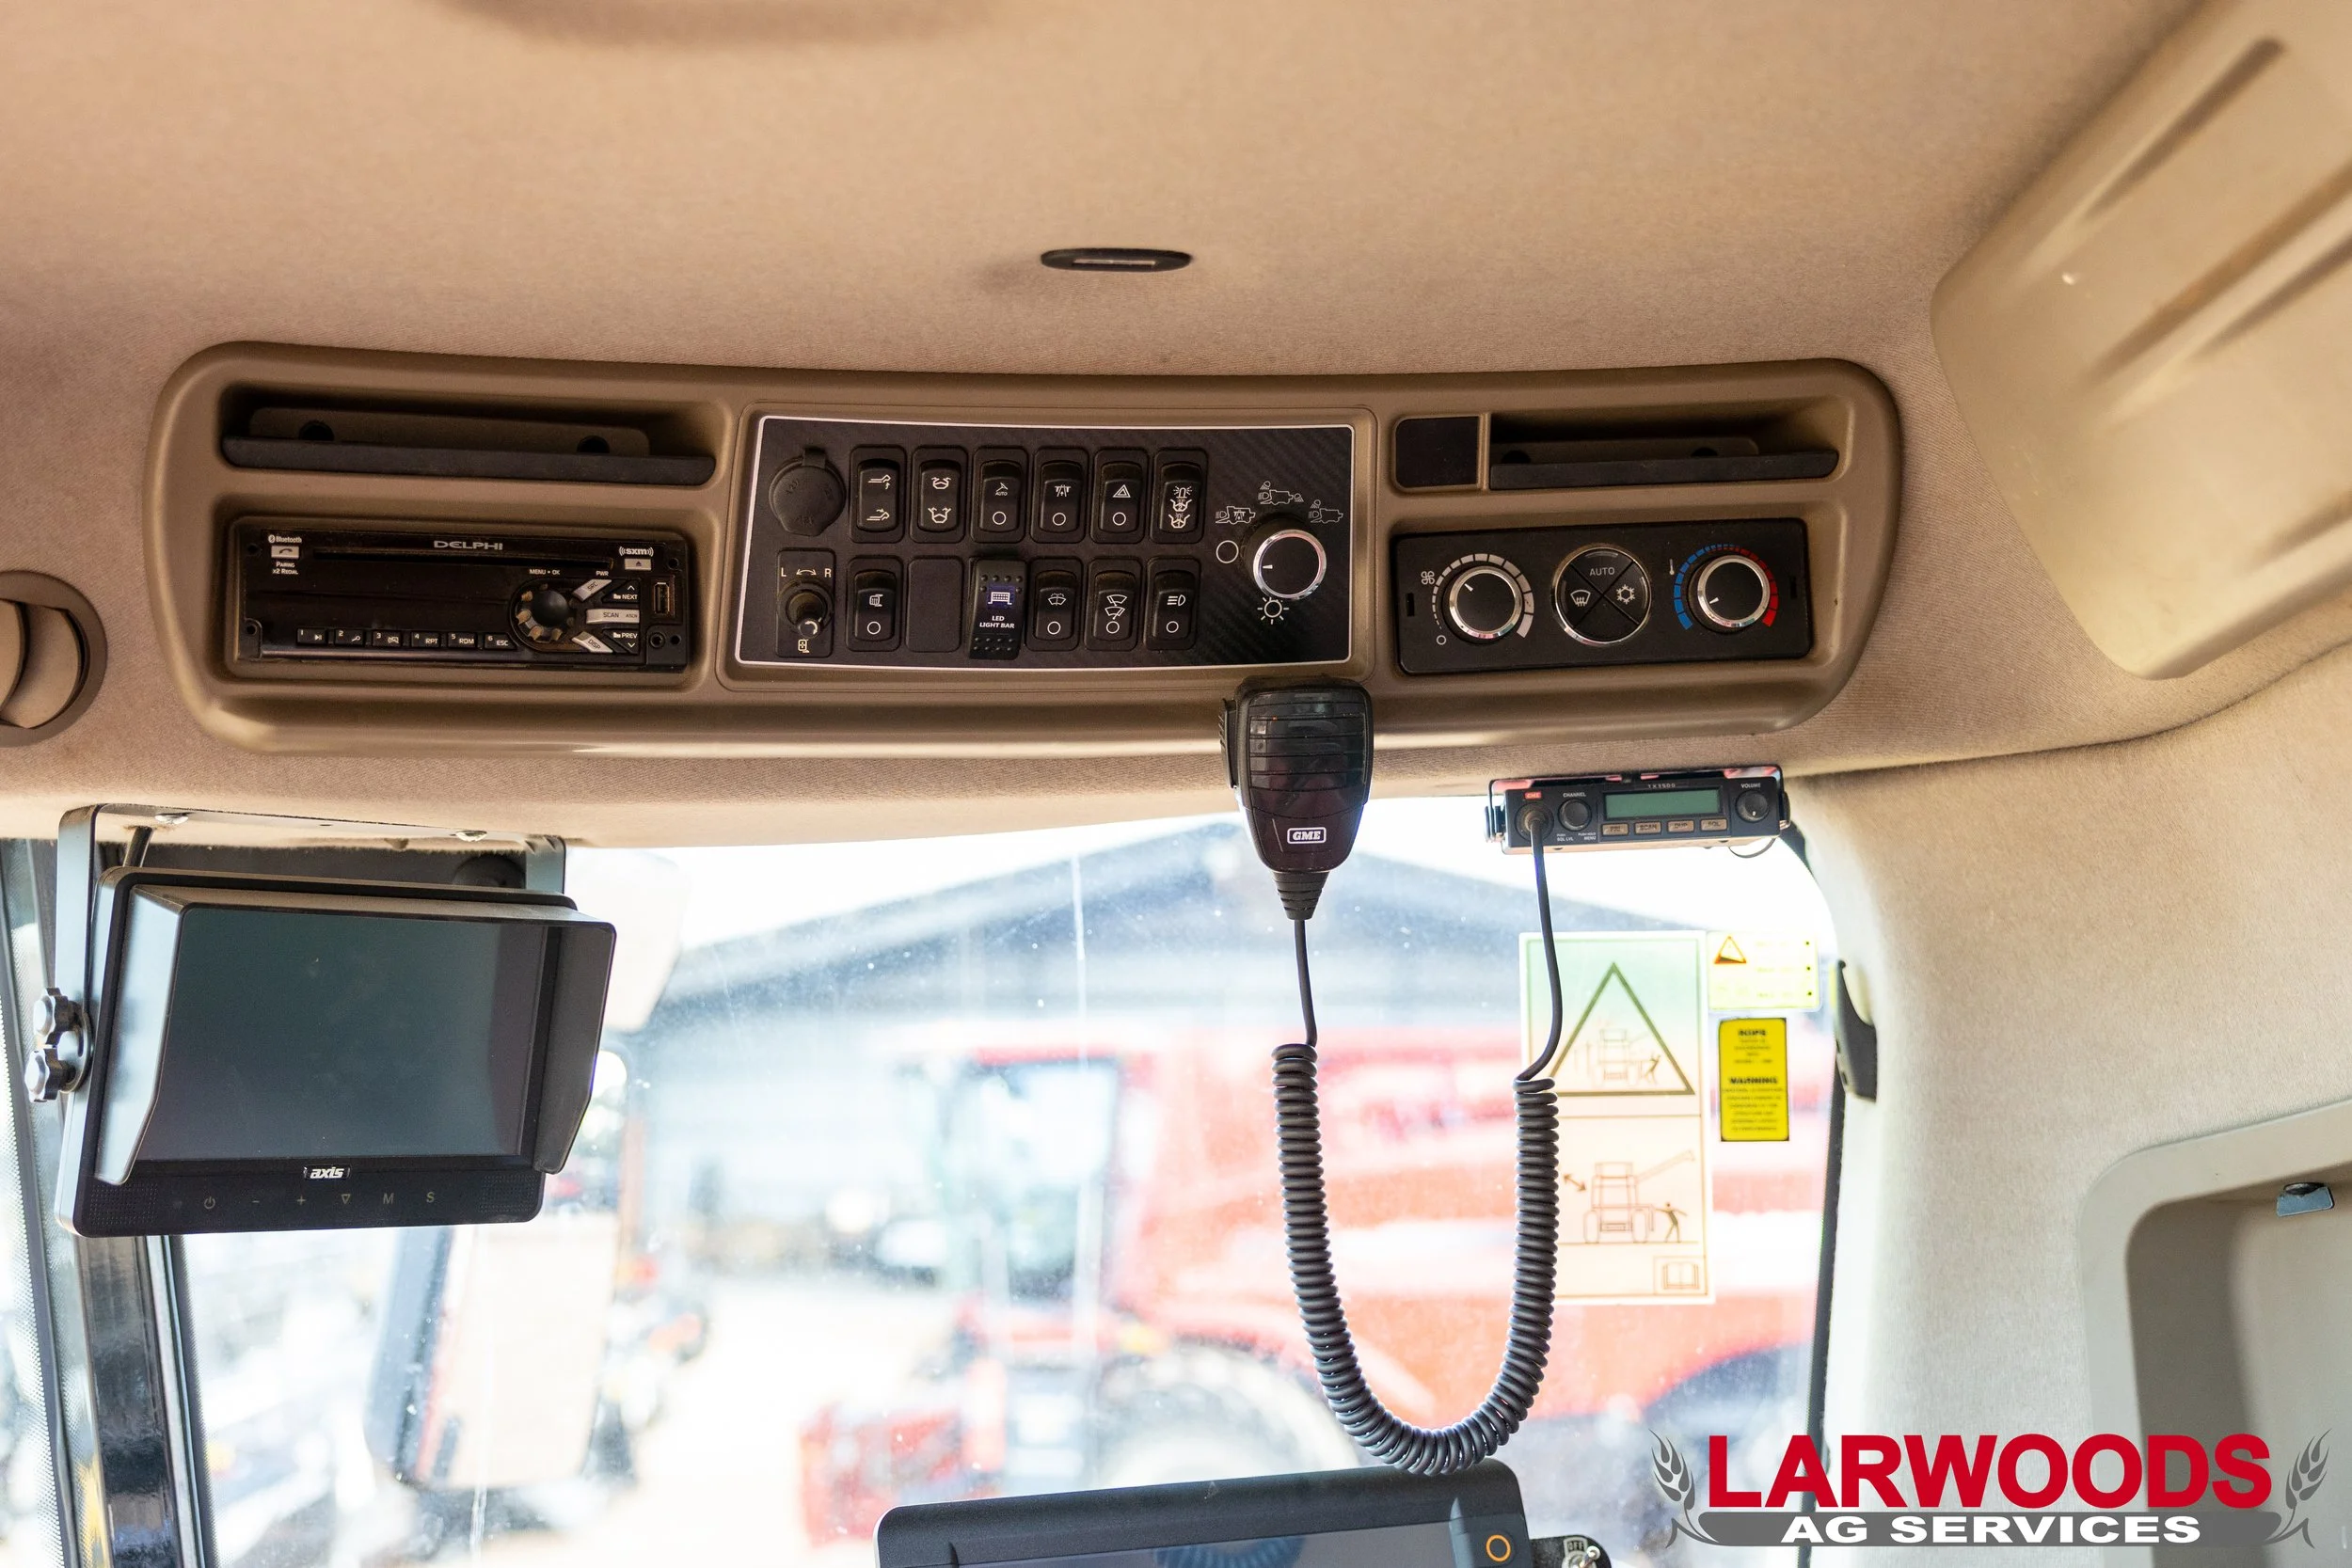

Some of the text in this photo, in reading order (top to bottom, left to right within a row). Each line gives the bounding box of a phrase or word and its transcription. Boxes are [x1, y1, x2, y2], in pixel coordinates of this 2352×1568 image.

[434, 540, 503, 550] DELPHI
[781, 568, 787, 578] L
[824, 568, 832, 578] R
[1589, 566, 1615, 577] AUTO
[587, 581, 598, 591] SRC
[587, 639, 601, 649] DISP
[1292, 831, 1321, 841] GME
[310, 1166, 344, 1179] axis
[383, 1192, 435, 1204] M S
